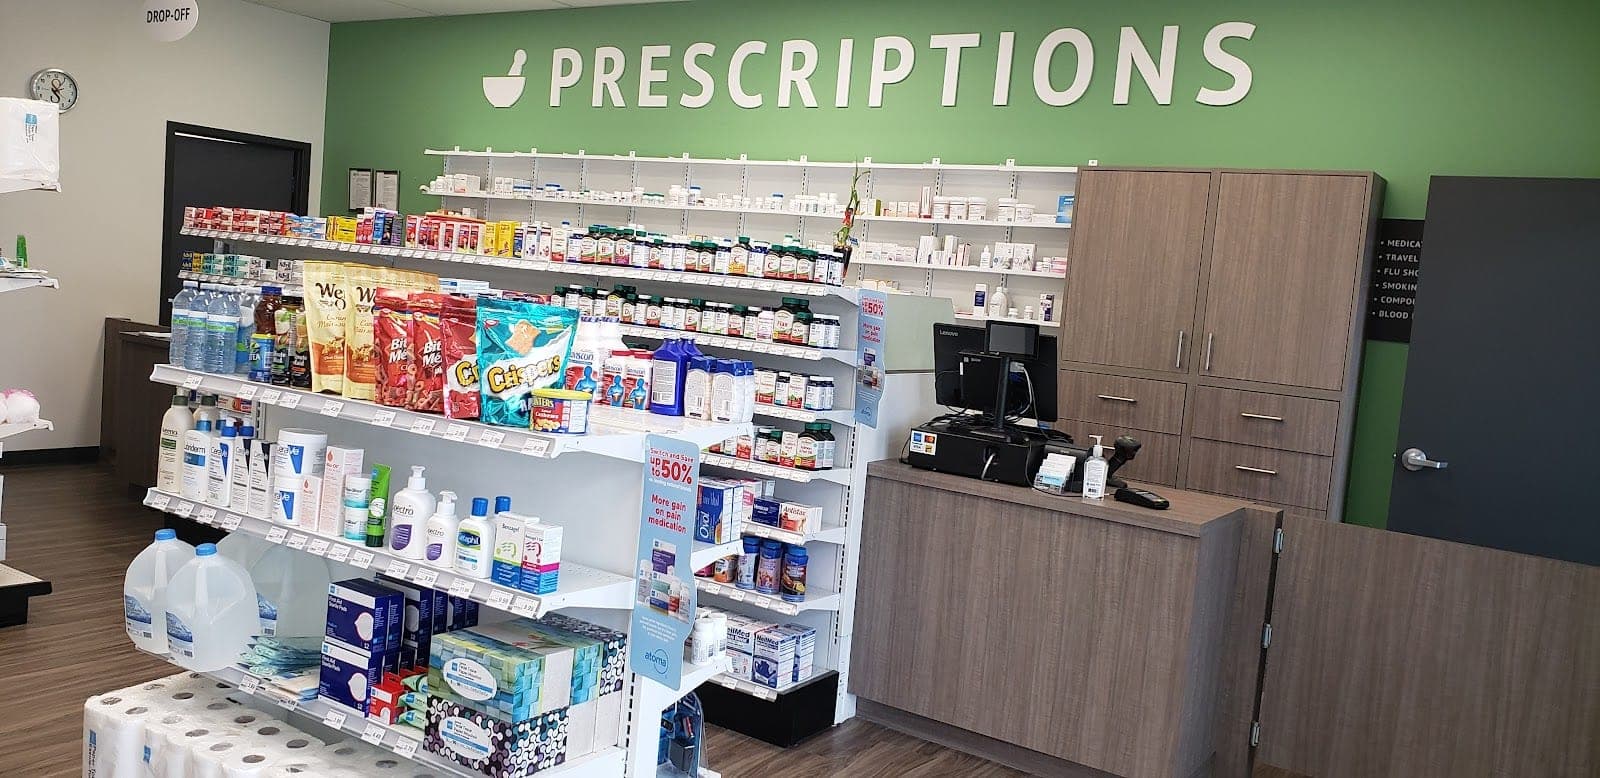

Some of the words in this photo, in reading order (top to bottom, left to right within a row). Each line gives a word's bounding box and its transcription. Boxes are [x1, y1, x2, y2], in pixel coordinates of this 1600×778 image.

[146, 7, 191, 23] DROP-OFF
[549, 21, 1257, 109] PRESCRIPTIONS
[1387, 239, 1423, 248] MEDICA
[1386, 253, 1418, 262] TRAVEL
[1384, 268, 1400, 276] FLU
[868, 302, 884, 316] 50%
[1378, 310, 1409, 319] BLOOD
[939, 329, 959, 337] Lenovo
[487, 354, 561, 394] Crispers
[650, 447, 669, 458] Switch
[650, 456, 661, 467] up
[651, 466, 661, 477] to
[661, 459, 692, 485] 50%
[651, 494, 670, 507] More
[671, 502, 687, 512] gain
[655, 507, 665, 516] on
[666, 510, 682, 521] pain
[648, 516, 687, 534] medication
[699, 511, 710, 539] Ovol
[644, 651, 667, 667] atoma
